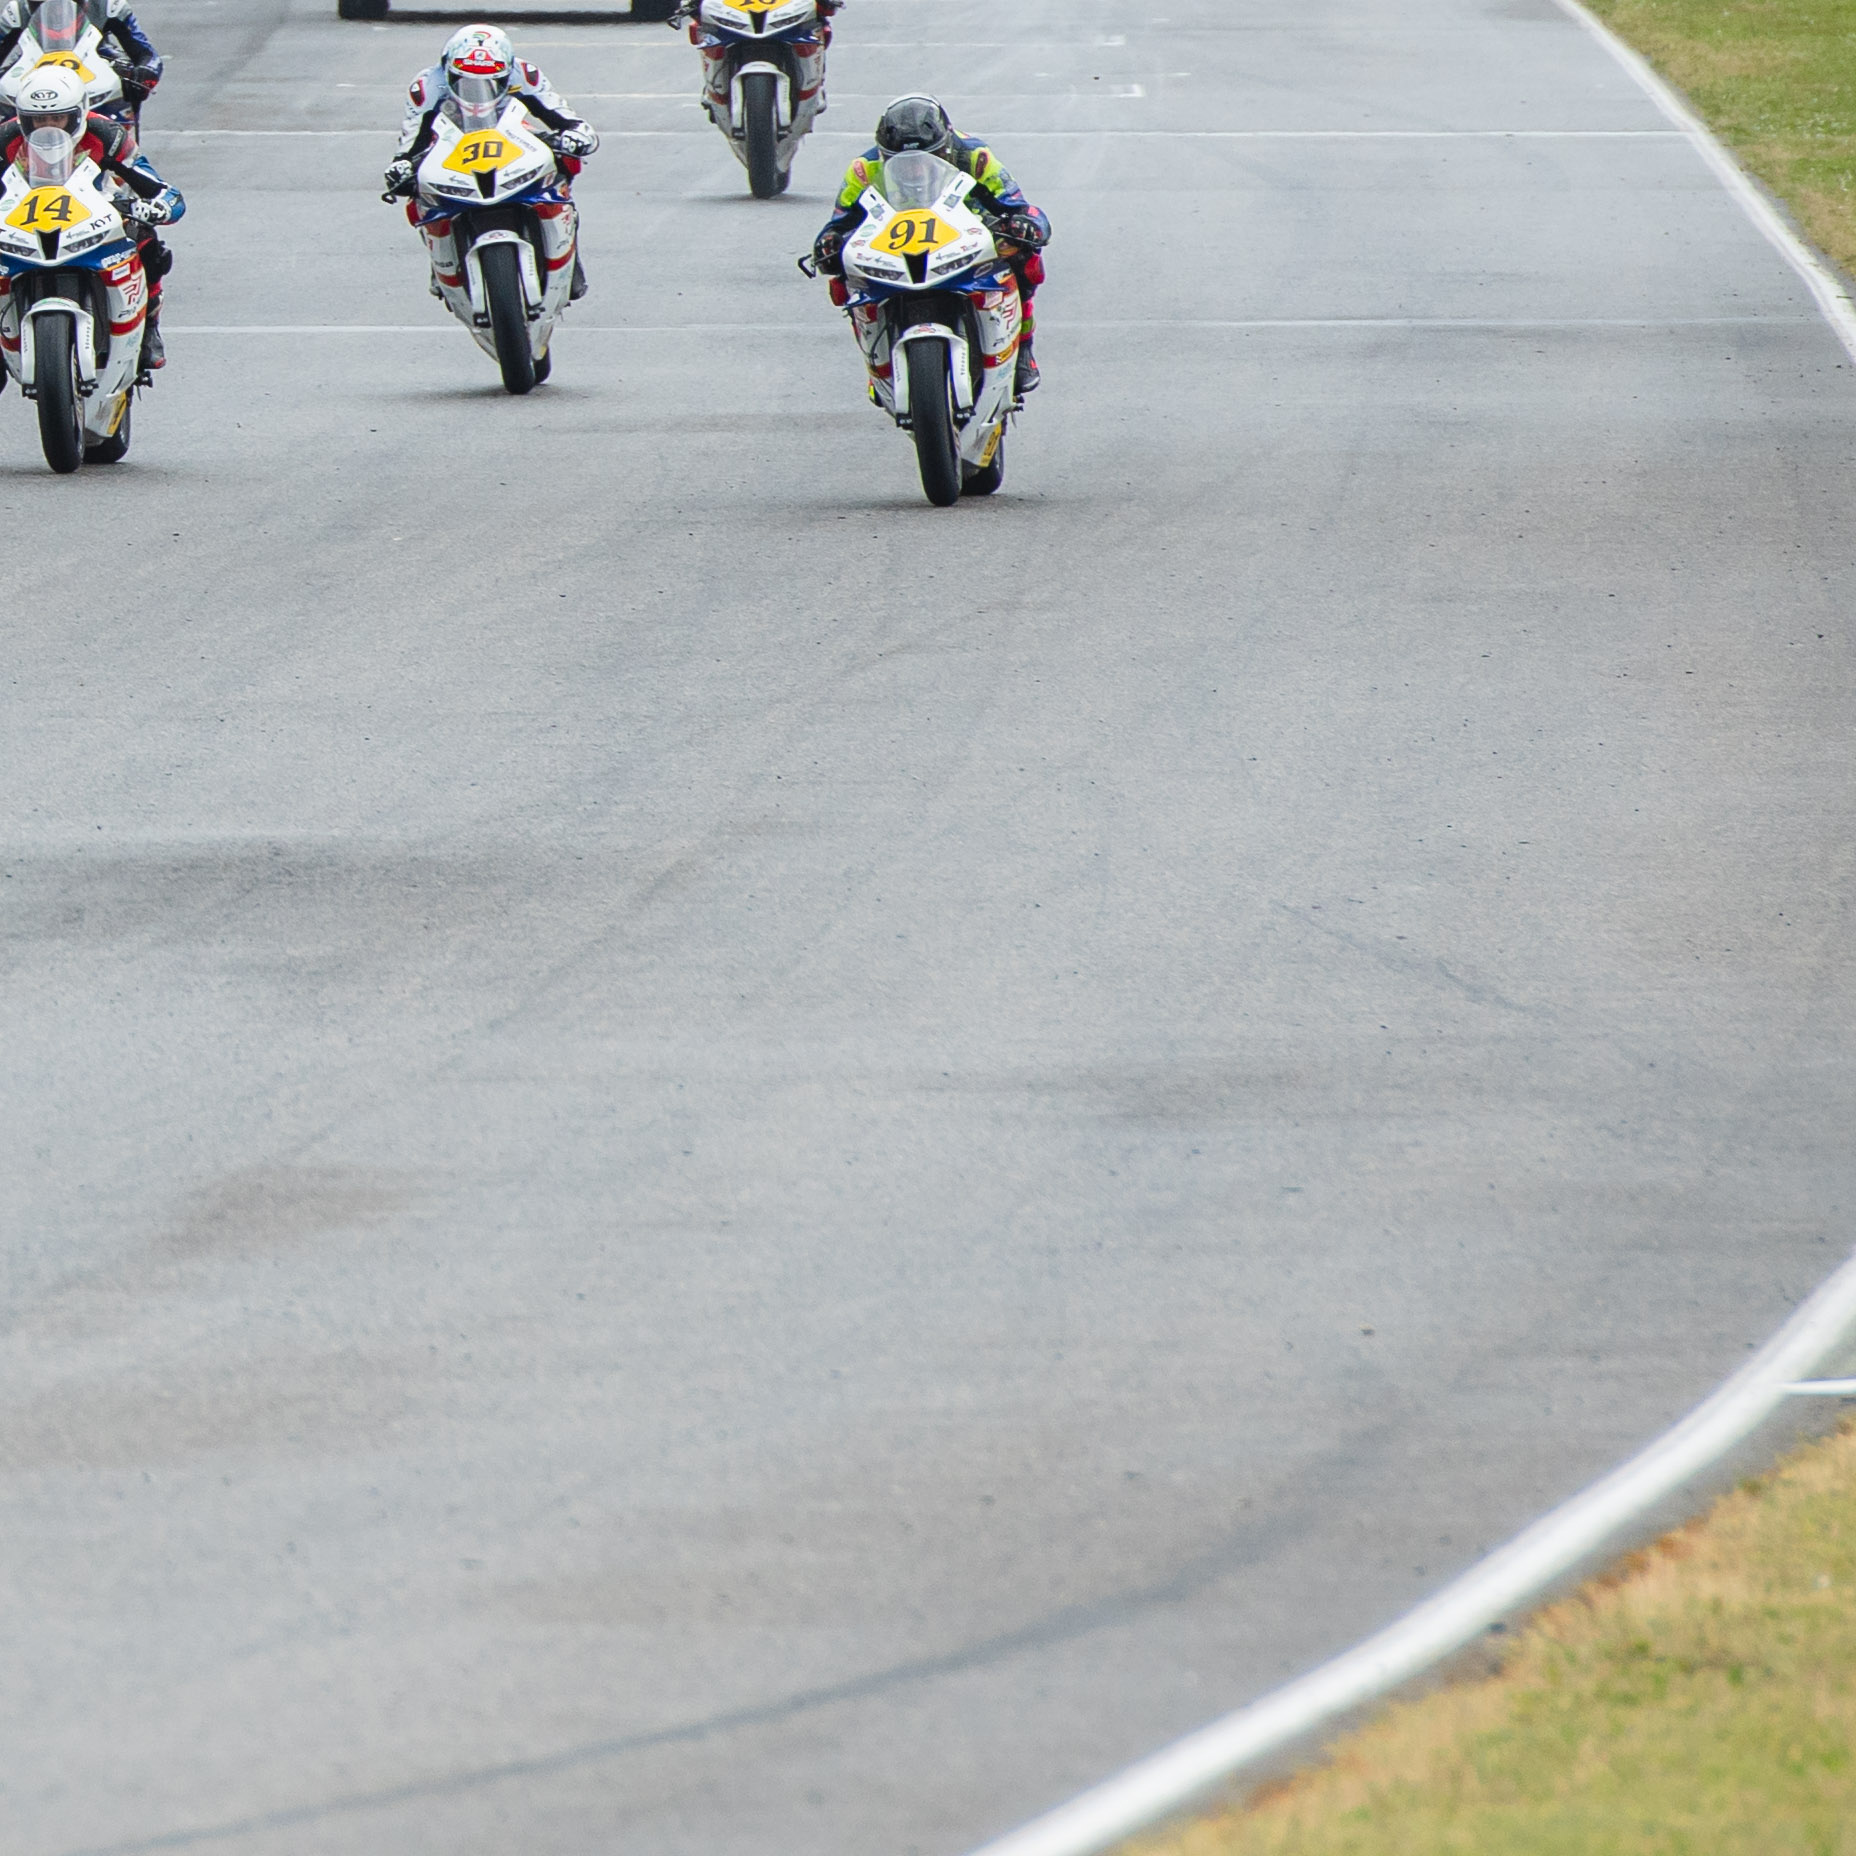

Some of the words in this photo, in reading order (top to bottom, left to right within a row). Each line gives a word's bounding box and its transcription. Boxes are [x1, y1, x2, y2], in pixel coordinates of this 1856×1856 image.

[462, 140, 504, 165] 30
[20, 194, 73, 227] 14
[888, 217, 939, 250] 91
